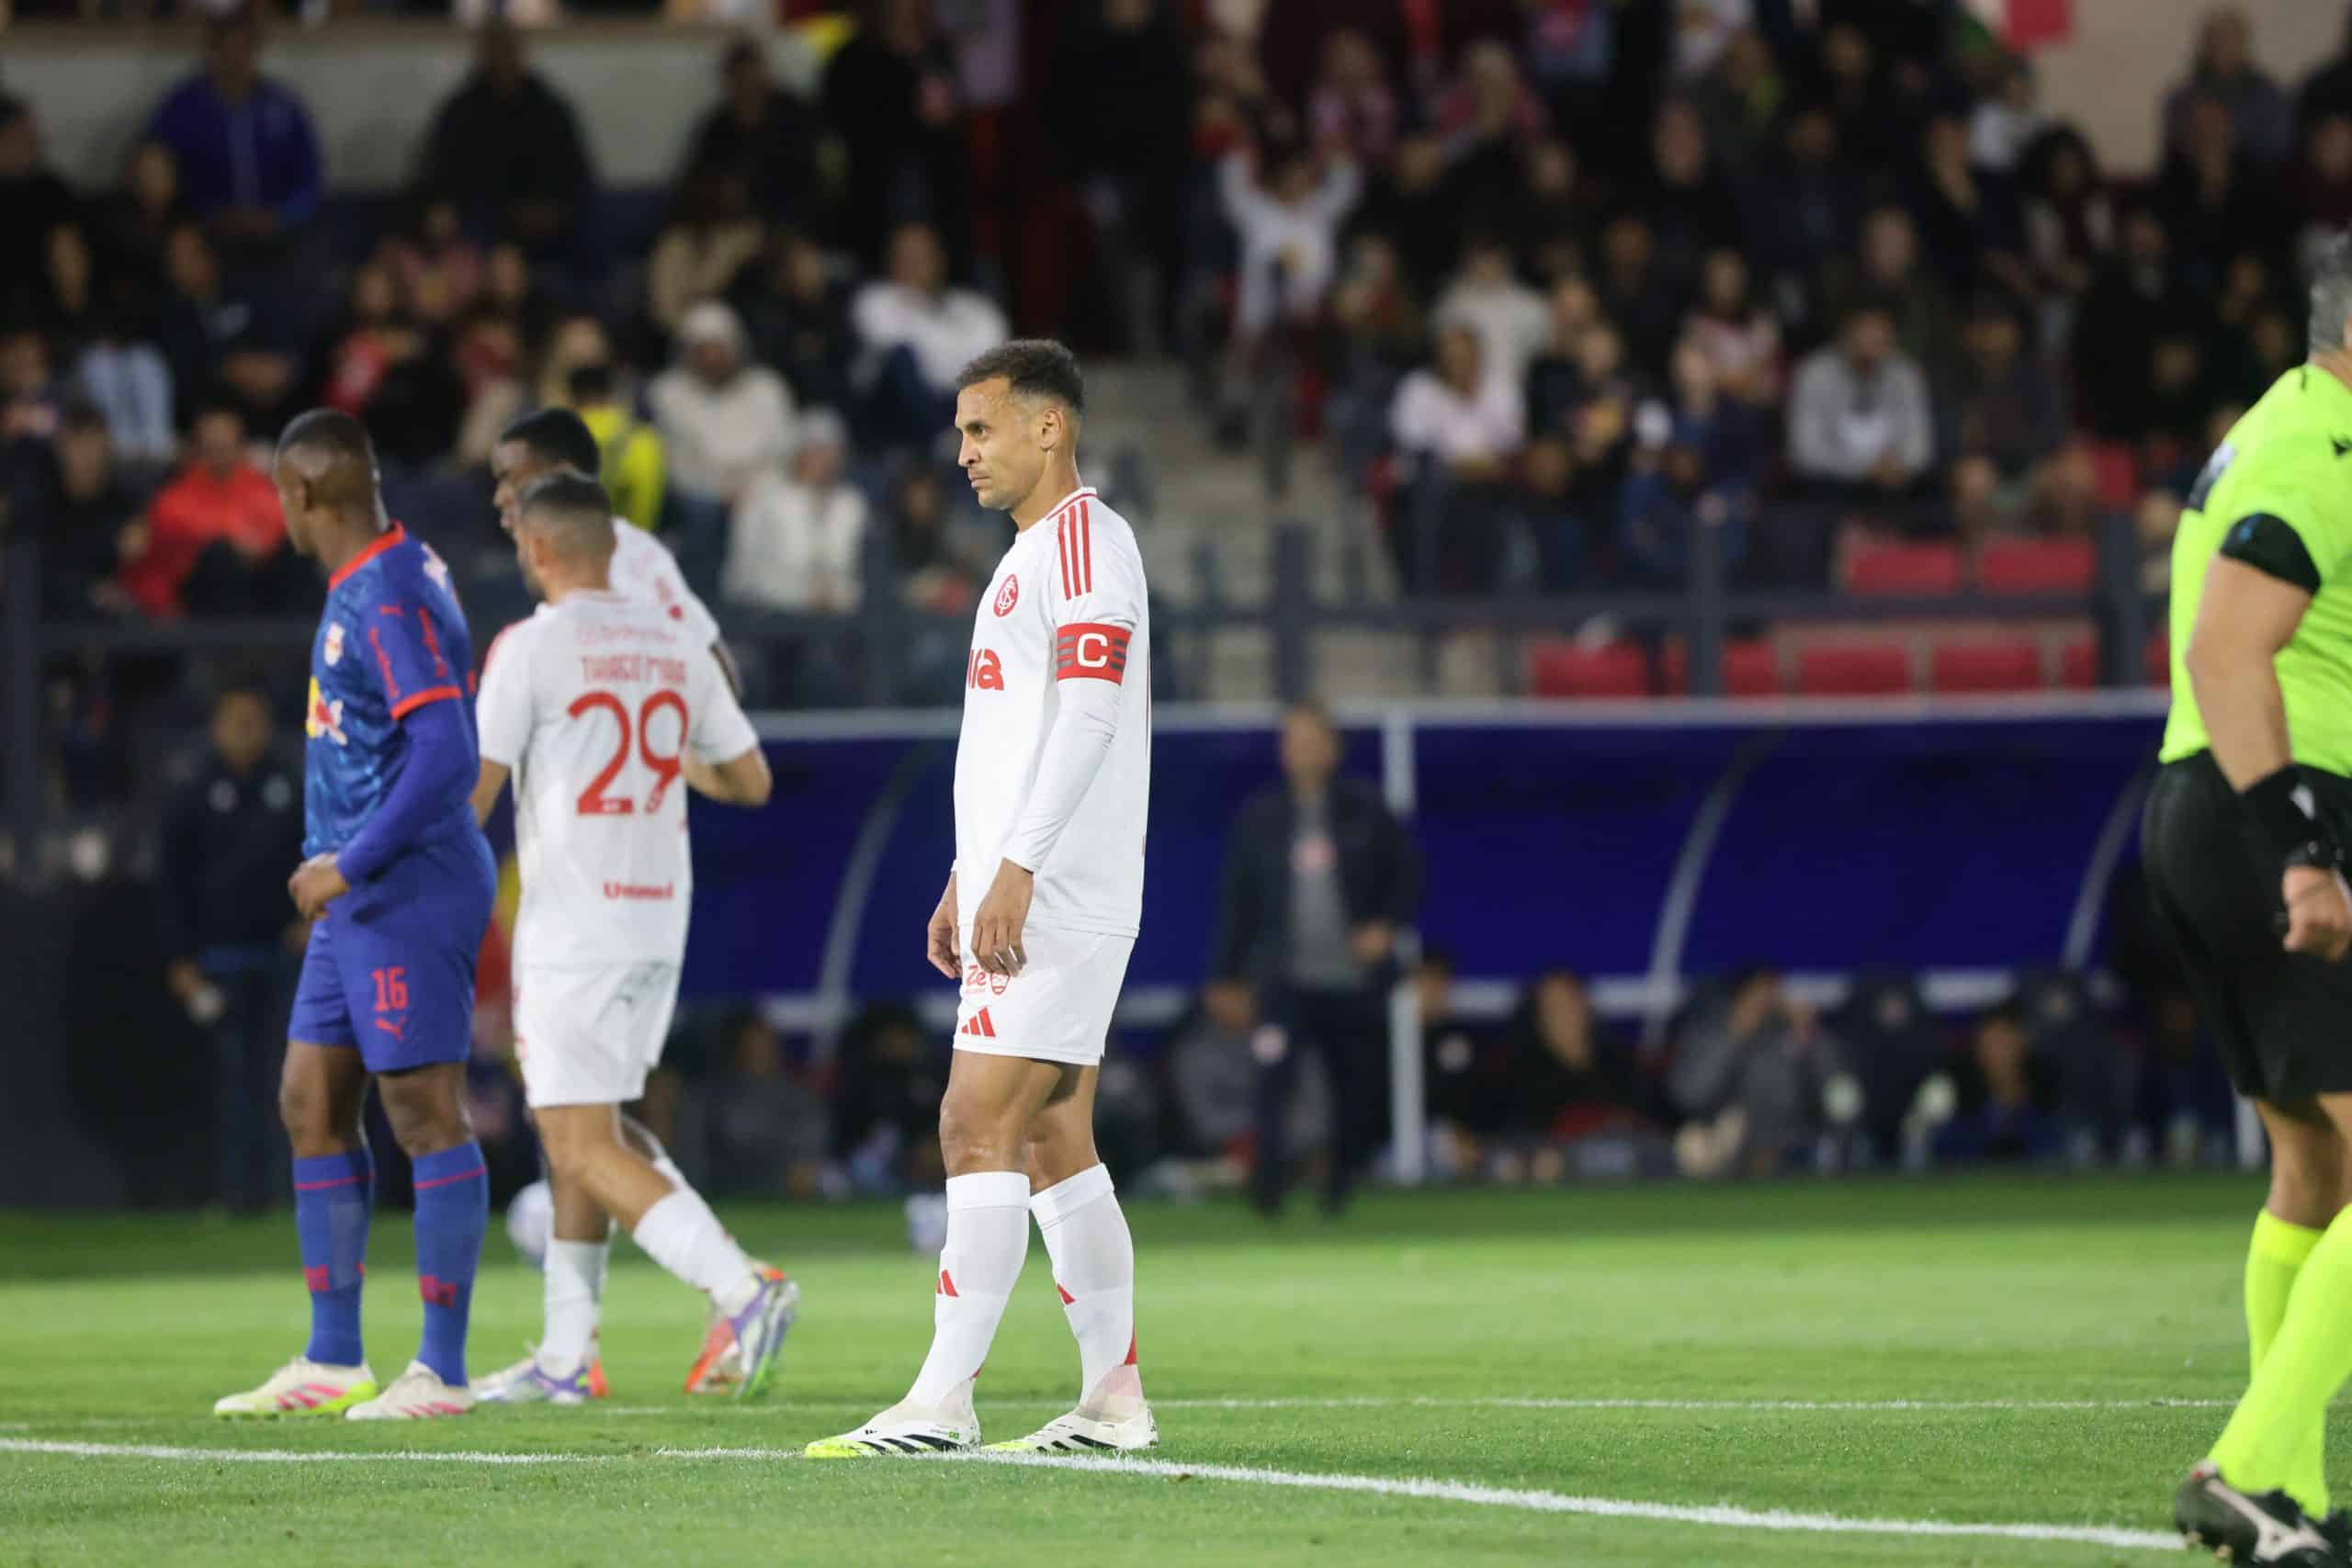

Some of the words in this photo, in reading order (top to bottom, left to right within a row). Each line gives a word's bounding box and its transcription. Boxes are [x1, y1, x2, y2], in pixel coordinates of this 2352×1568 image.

[1077, 633, 1108, 668] C
[568, 690, 690, 815] 29
[371, 967, 408, 1012] 16
